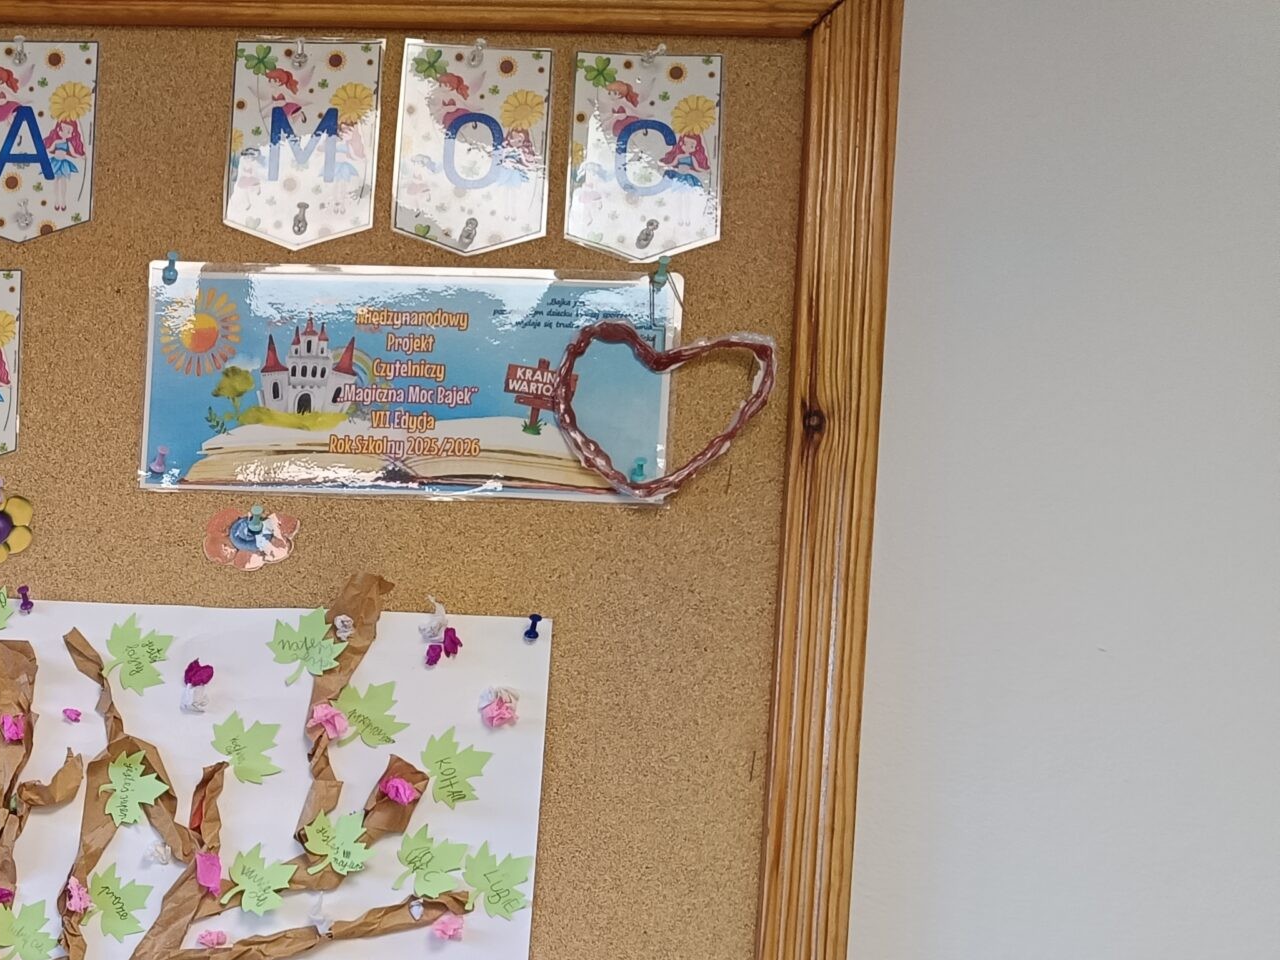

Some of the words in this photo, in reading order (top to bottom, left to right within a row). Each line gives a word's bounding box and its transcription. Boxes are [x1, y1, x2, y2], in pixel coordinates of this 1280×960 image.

[355, 307, 469, 331] Międzynarodowy
[386, 333, 435, 354] Projekt
[372, 358, 445, 381] Czytelniczy
[408, 386, 433, 404] Moc
[371, 410, 391, 429] VII
[393, 411, 436, 433] Edycja
[328, 434, 352, 454] Rok
[355, 435, 405, 457] Szkolny
[407, 437, 480, 457] 2025/2026
